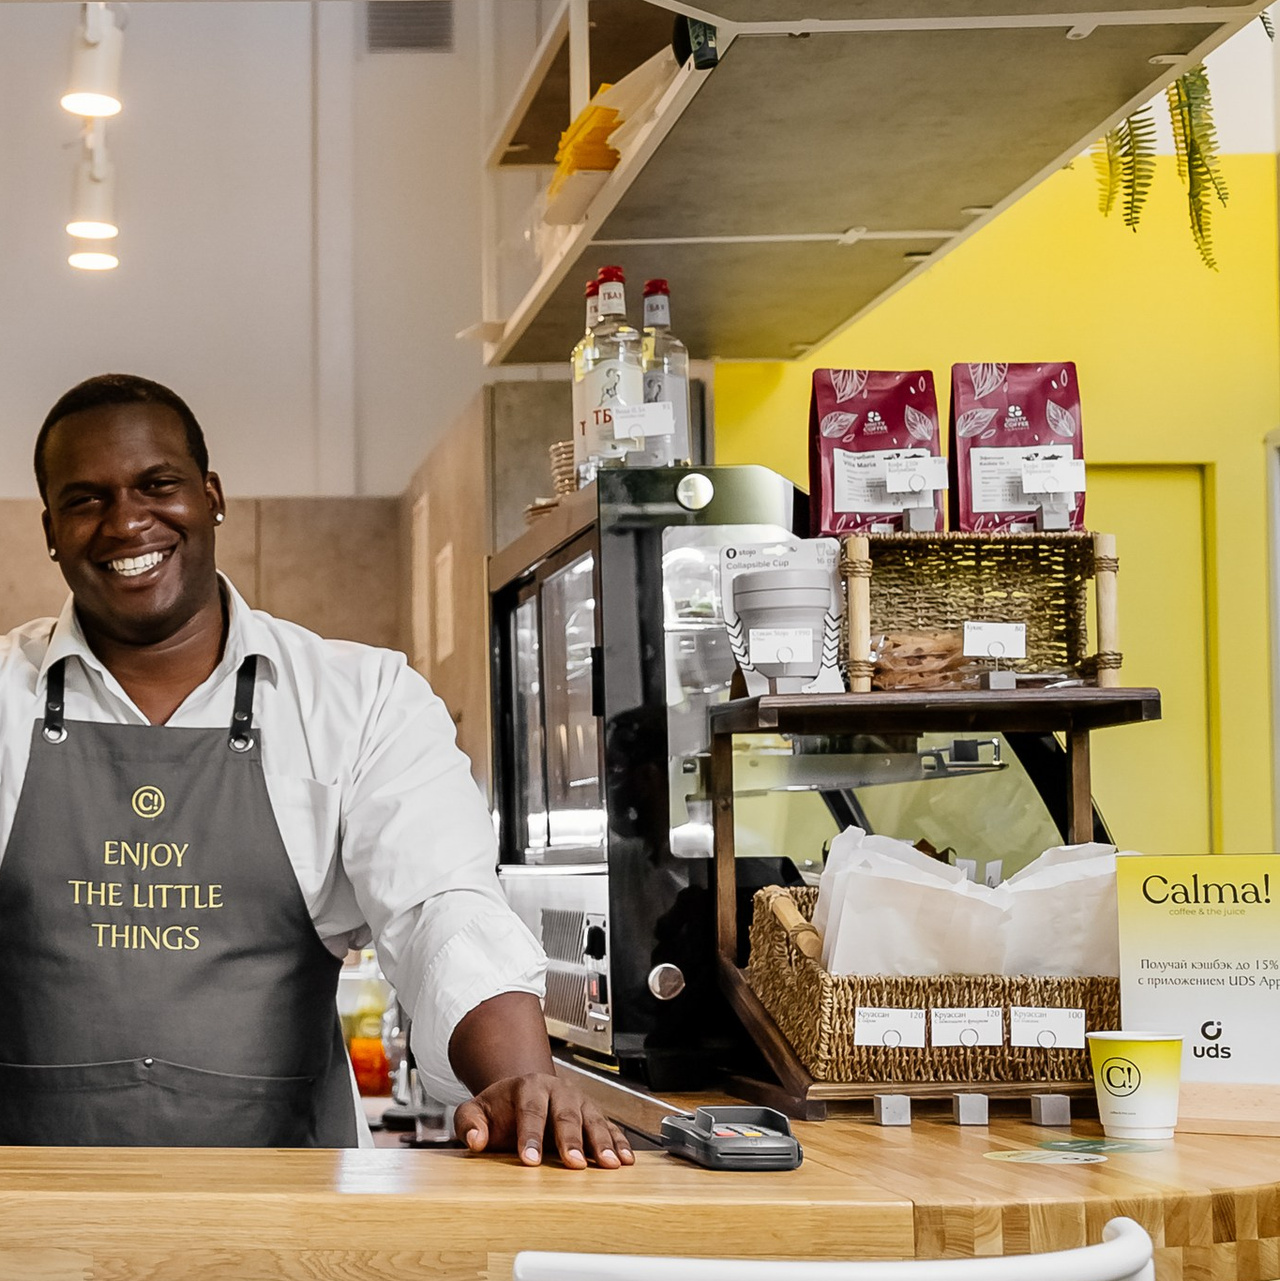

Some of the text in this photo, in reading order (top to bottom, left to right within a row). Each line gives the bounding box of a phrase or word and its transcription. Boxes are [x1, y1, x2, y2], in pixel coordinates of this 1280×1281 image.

[739, 549, 756, 557] stojo
[726, 560, 790, 570] Collapsible Cup
[137, 792, 159, 811] C!
[104, 840, 189, 871] ENJOY
[68, 880, 224, 909] THE LITTLE
[1142, 873, 1271, 904] Calma!
[1223, 908, 1246, 917] juice
[91, 923, 201, 950] THINGS
[1140, 959, 1279, 973] Получай кэшбэк до 15%
[1147, 976, 1225, 988] приложением
[1229, 976, 1256, 986] UDS
[858, 1010, 924, 1020] Круассан 120
[934, 1010, 1000, 1019] Круассан 120
[1014, 1010, 1083, 1019] Круассан 100
[1193, 1043, 1232, 1059] uds
[1105, 1066, 1133, 1089] C!
